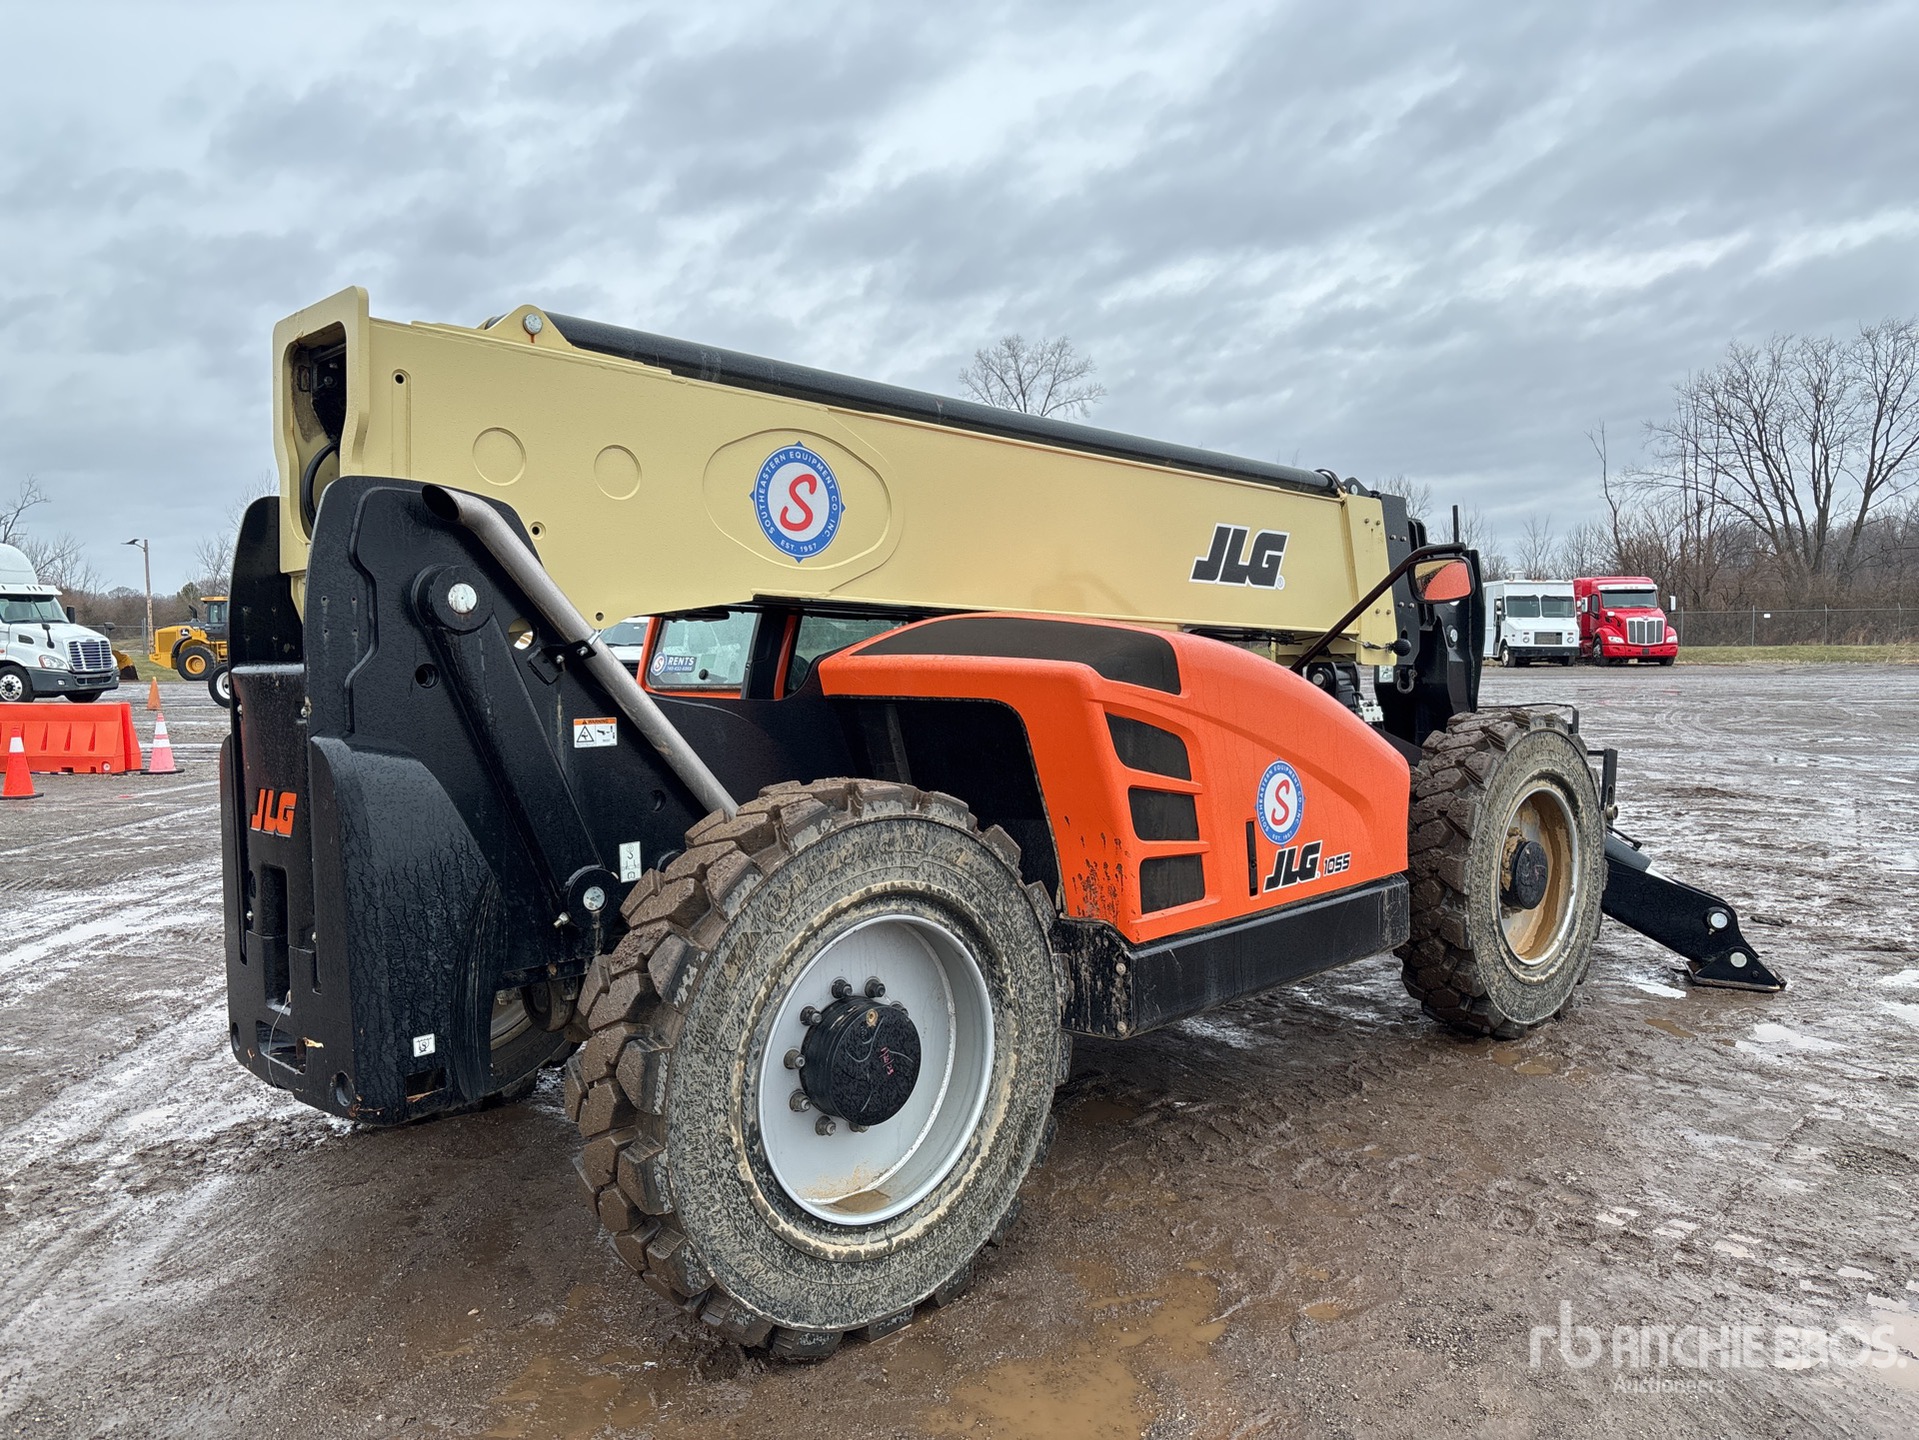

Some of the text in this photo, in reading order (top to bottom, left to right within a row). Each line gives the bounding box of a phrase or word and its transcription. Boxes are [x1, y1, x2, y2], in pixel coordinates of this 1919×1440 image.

[758, 453, 787, 534] SOUTHEASTERN
[789, 451, 834, 490] EQUIPMENT
[822, 519, 836, 538] INC.
[780, 474, 817, 532] S
[780, 539, 817, 553] EST. 1957
[1190, 524, 1288, 588] JLG
[668, 656, 694, 666] RENTS
[250, 788, 297, 838] JLG
[1271, 779, 1290, 826] S
[1263, 841, 1350, 892] JLG 1055
